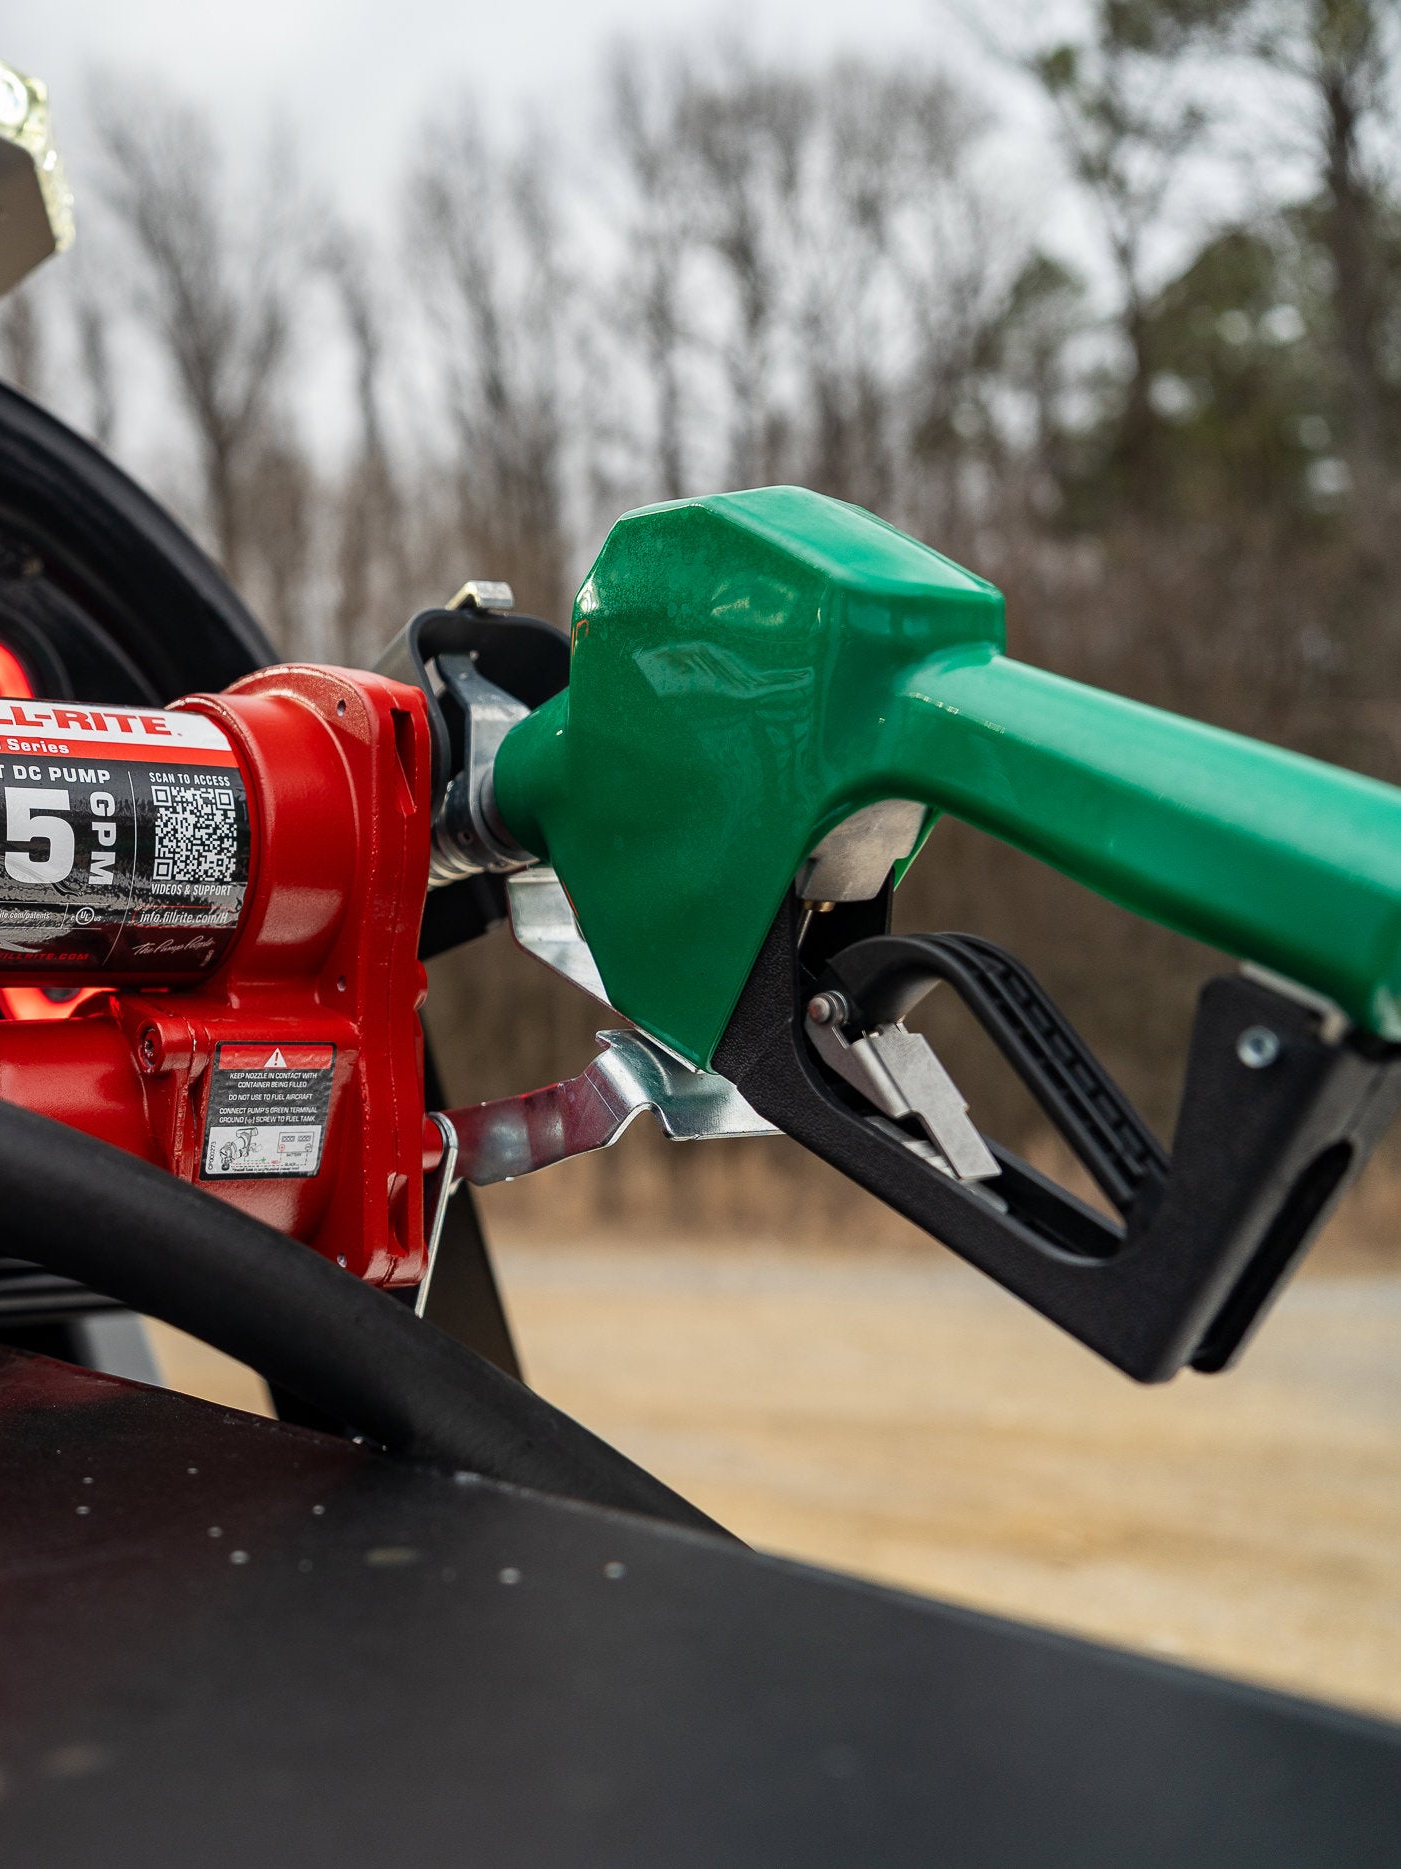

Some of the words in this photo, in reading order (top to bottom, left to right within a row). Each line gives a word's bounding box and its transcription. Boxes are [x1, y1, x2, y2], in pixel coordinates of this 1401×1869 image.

[8, 738, 70, 754] Series
[12, 765, 42, 780] DC
[48, 767, 111, 784] PUMP
[149, 772, 175, 783] SCAN
[178, 773, 190, 784] TO
[194, 774, 230, 787] ACCESS
[88, 791, 117, 885] GPM
[151, 883, 182, 895] VIDEOS
[184, 884, 190, 895] &
[192, 884, 232, 896] SUPPORT
[139, 911, 229, 924] info.fillrite.com/H
